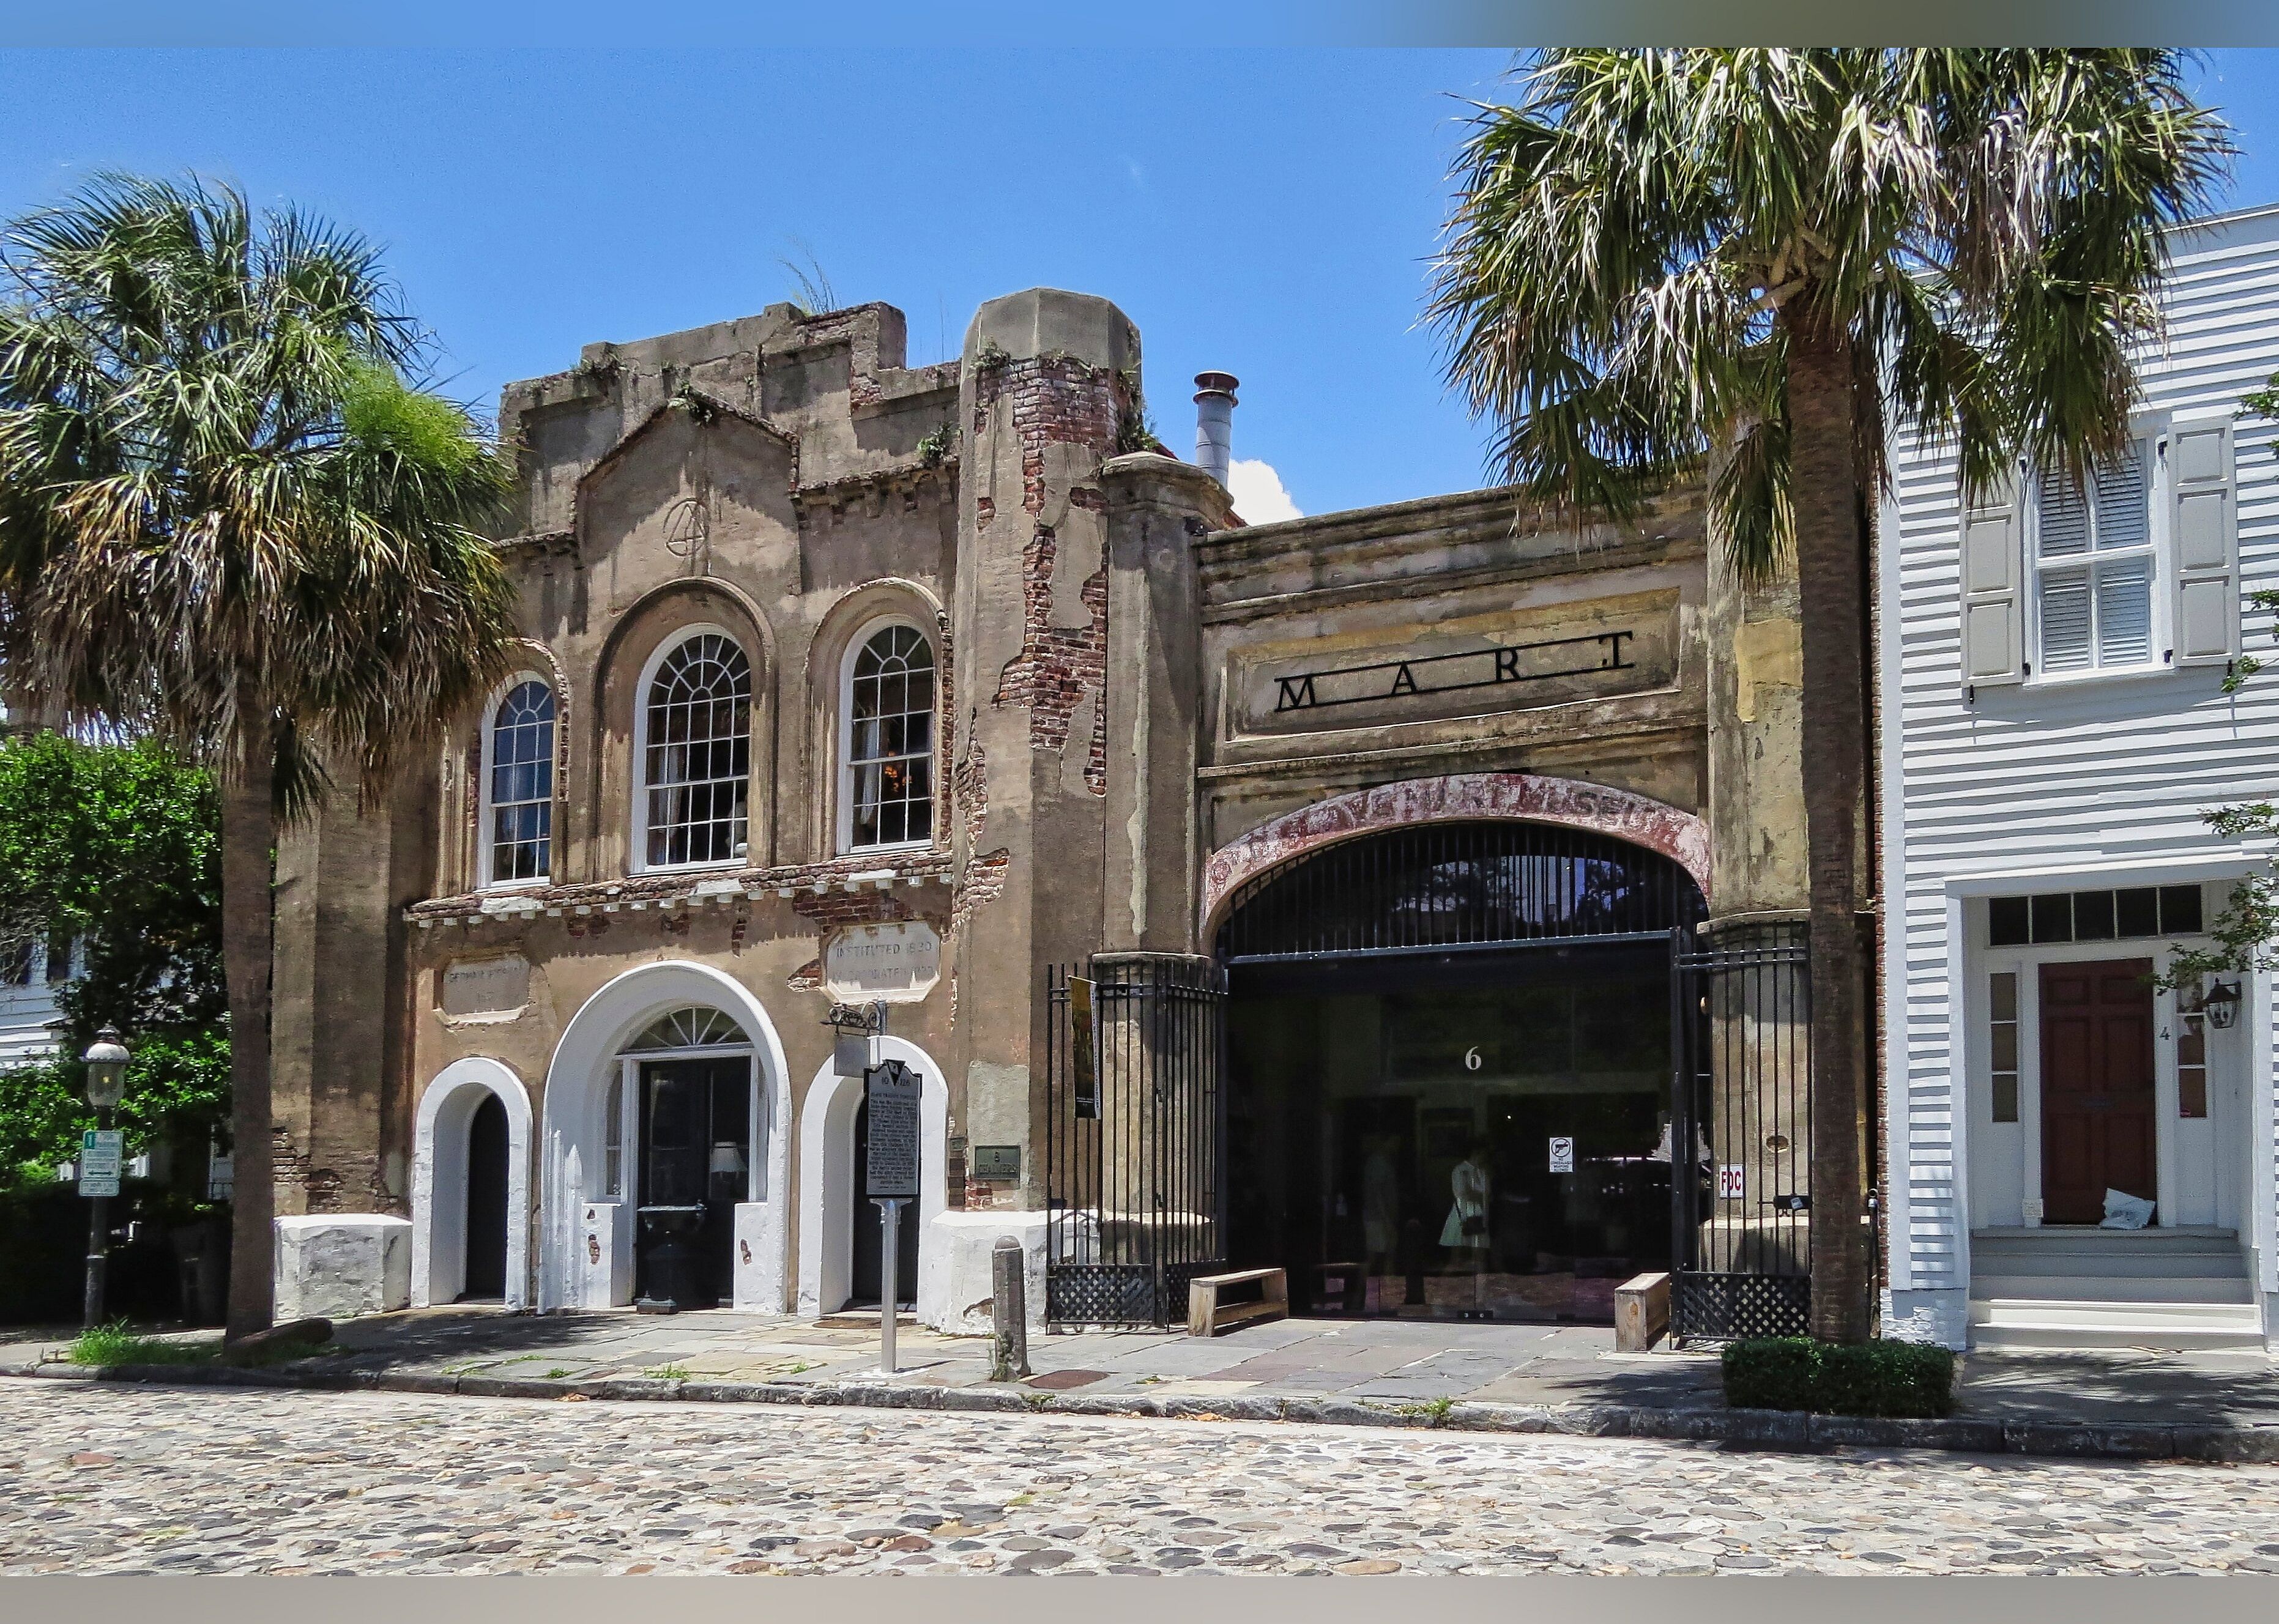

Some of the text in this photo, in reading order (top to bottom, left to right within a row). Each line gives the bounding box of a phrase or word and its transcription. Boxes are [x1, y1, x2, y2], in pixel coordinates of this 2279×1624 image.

[1274, 631, 1634, 712] MART
[2159, 1026, 2171, 1040] 4
[1465, 1046, 1482, 1070] 6
[1721, 1171, 1741, 1191] FDC
